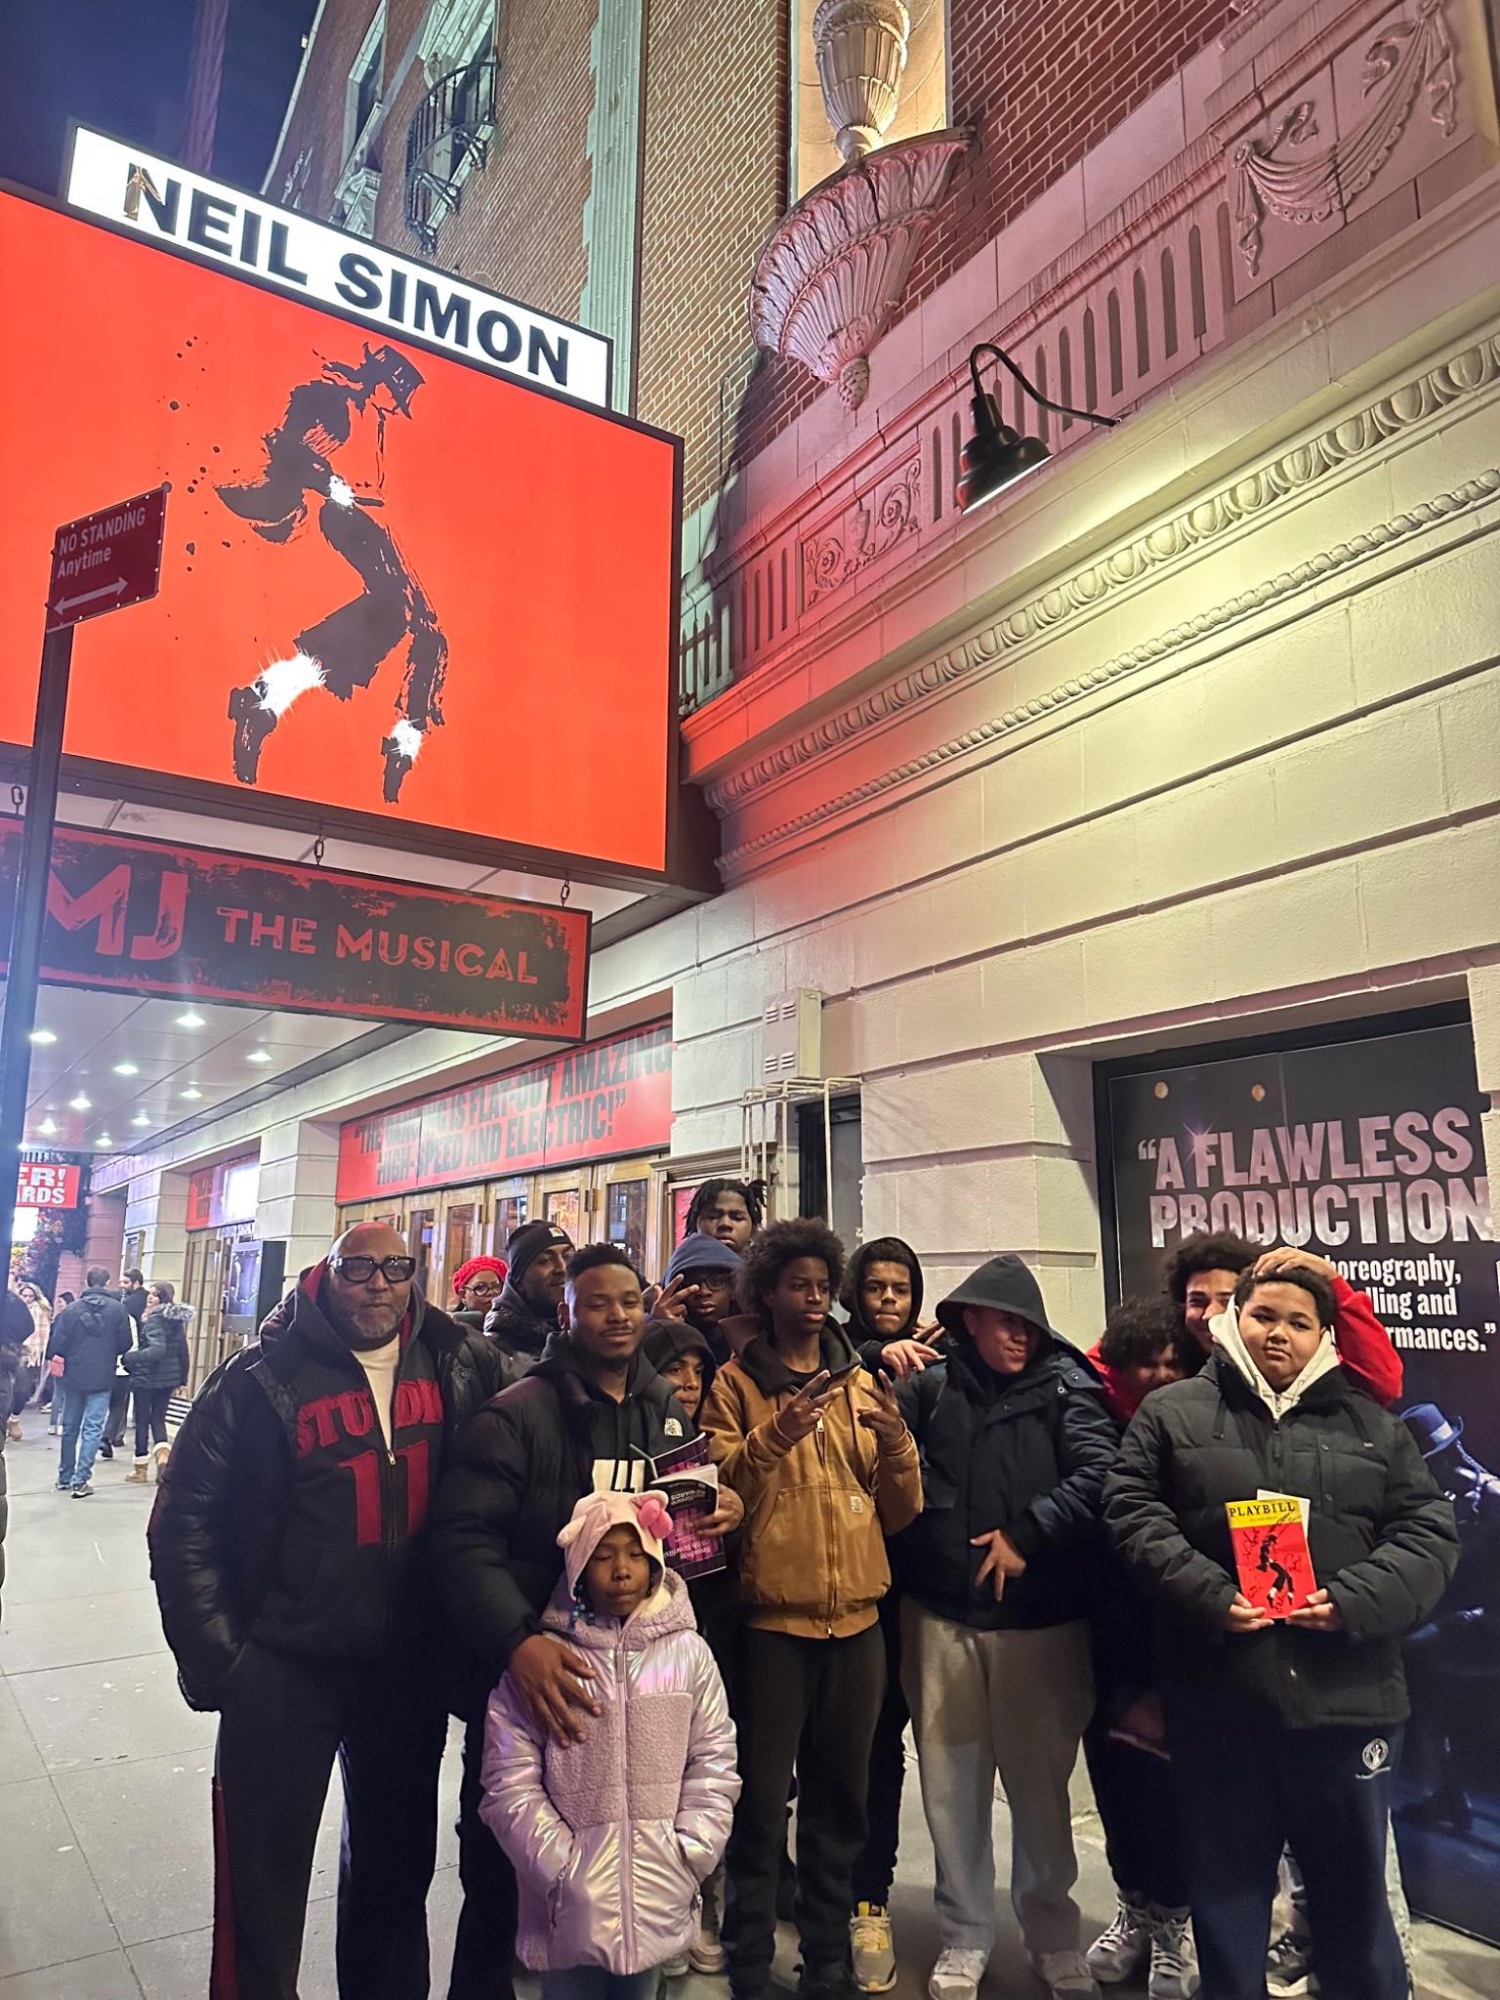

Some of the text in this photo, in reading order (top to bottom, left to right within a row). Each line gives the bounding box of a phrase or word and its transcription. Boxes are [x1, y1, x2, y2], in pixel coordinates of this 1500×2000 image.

[121, 162, 568, 387] NEIL SIMON
[60, 507, 146, 556] NO STANDING
[57, 547, 112, 579] Anytime
[45, 864, 538, 984] MJ THE MUSICAL
[451, 1090, 466, 1131] IS
[470, 1063, 556, 1126] FLAT-OUT
[559, 1026, 673, 1100] AMAZING
[466, 1123, 502, 1166] AND
[1193, 1107, 1474, 1188] FLAWLESS
[1150, 1177, 1496, 1248] PRODUCTION
[1417, 1287, 1458, 1316] and
[1228, 1501, 1296, 1518] PLAYBILL
